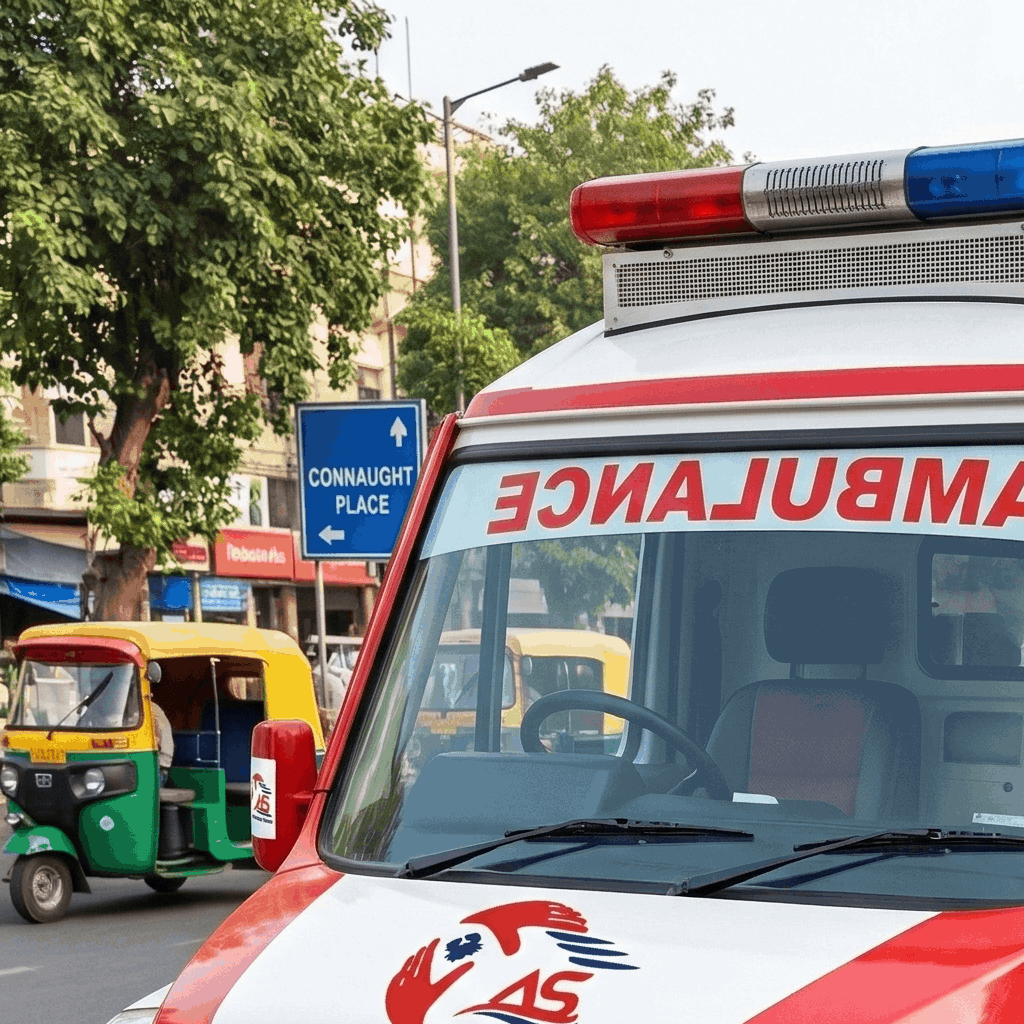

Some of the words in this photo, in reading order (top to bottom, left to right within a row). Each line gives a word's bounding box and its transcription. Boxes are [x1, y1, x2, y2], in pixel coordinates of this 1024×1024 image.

[308, 466, 413, 487] CONNAUGHT
[336, 494, 390, 515] PLACE
[487, 968, 594, 1024] AS
